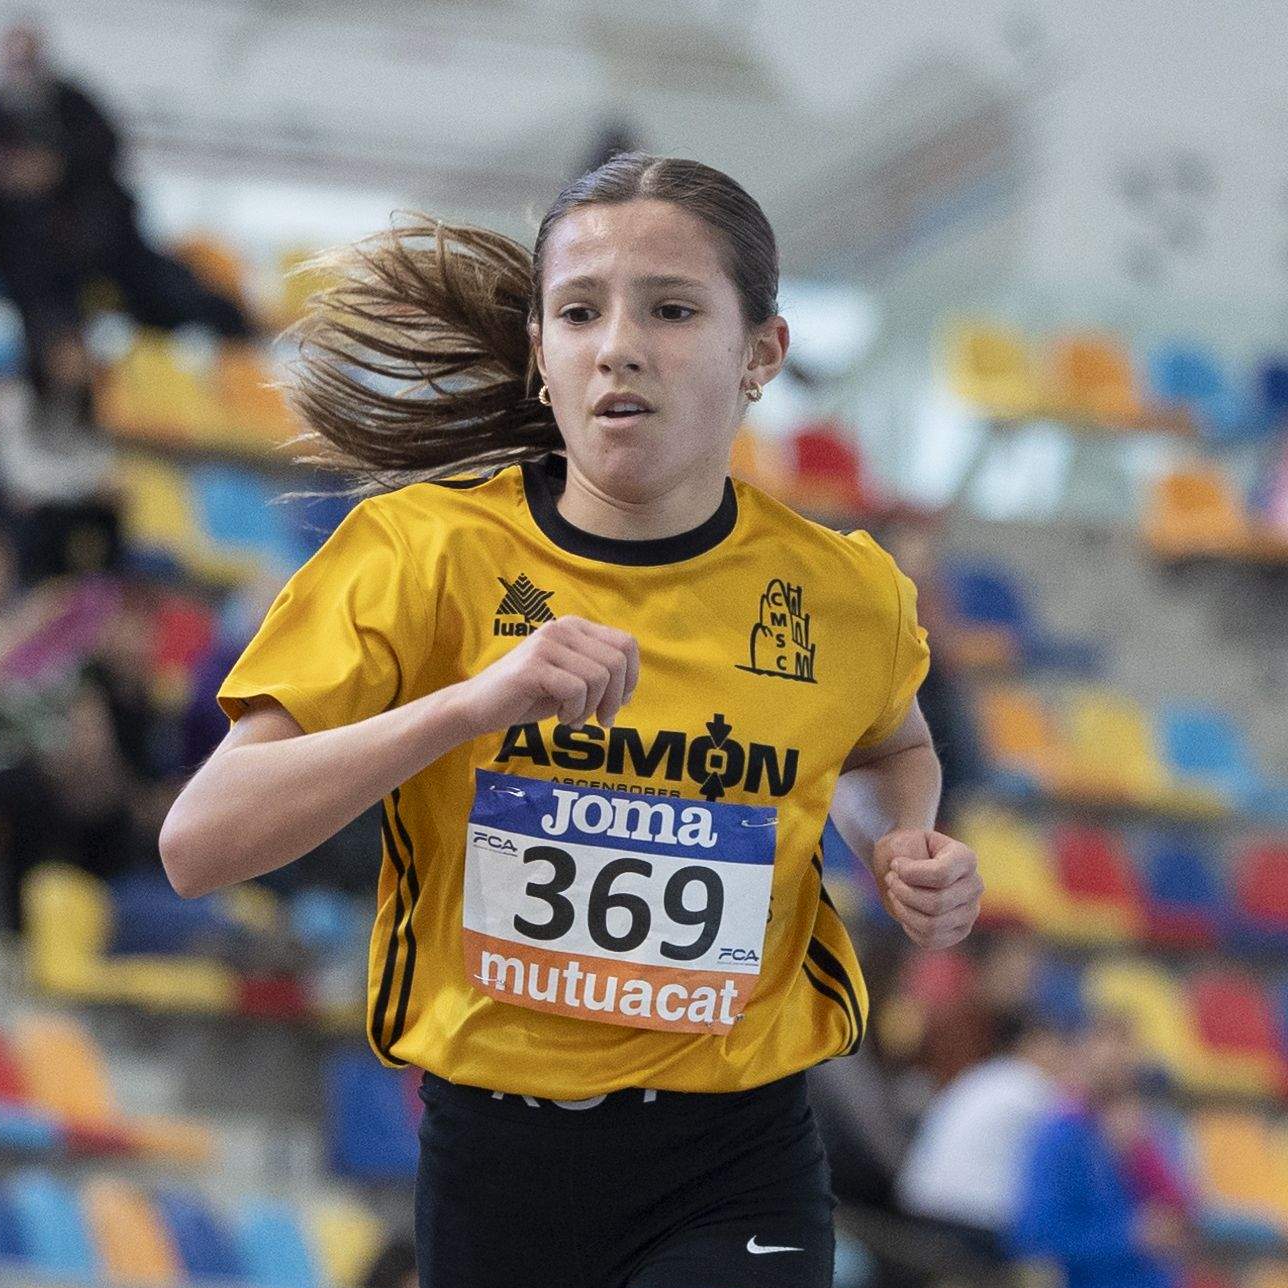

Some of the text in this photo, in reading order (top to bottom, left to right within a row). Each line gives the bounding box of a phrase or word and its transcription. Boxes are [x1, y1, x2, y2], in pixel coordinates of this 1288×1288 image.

[473, 831, 518, 852] FCA
[512, 845, 725, 961] 369
[718, 947, 759, 961] FCA
[480, 950, 738, 1025] mutuacat
